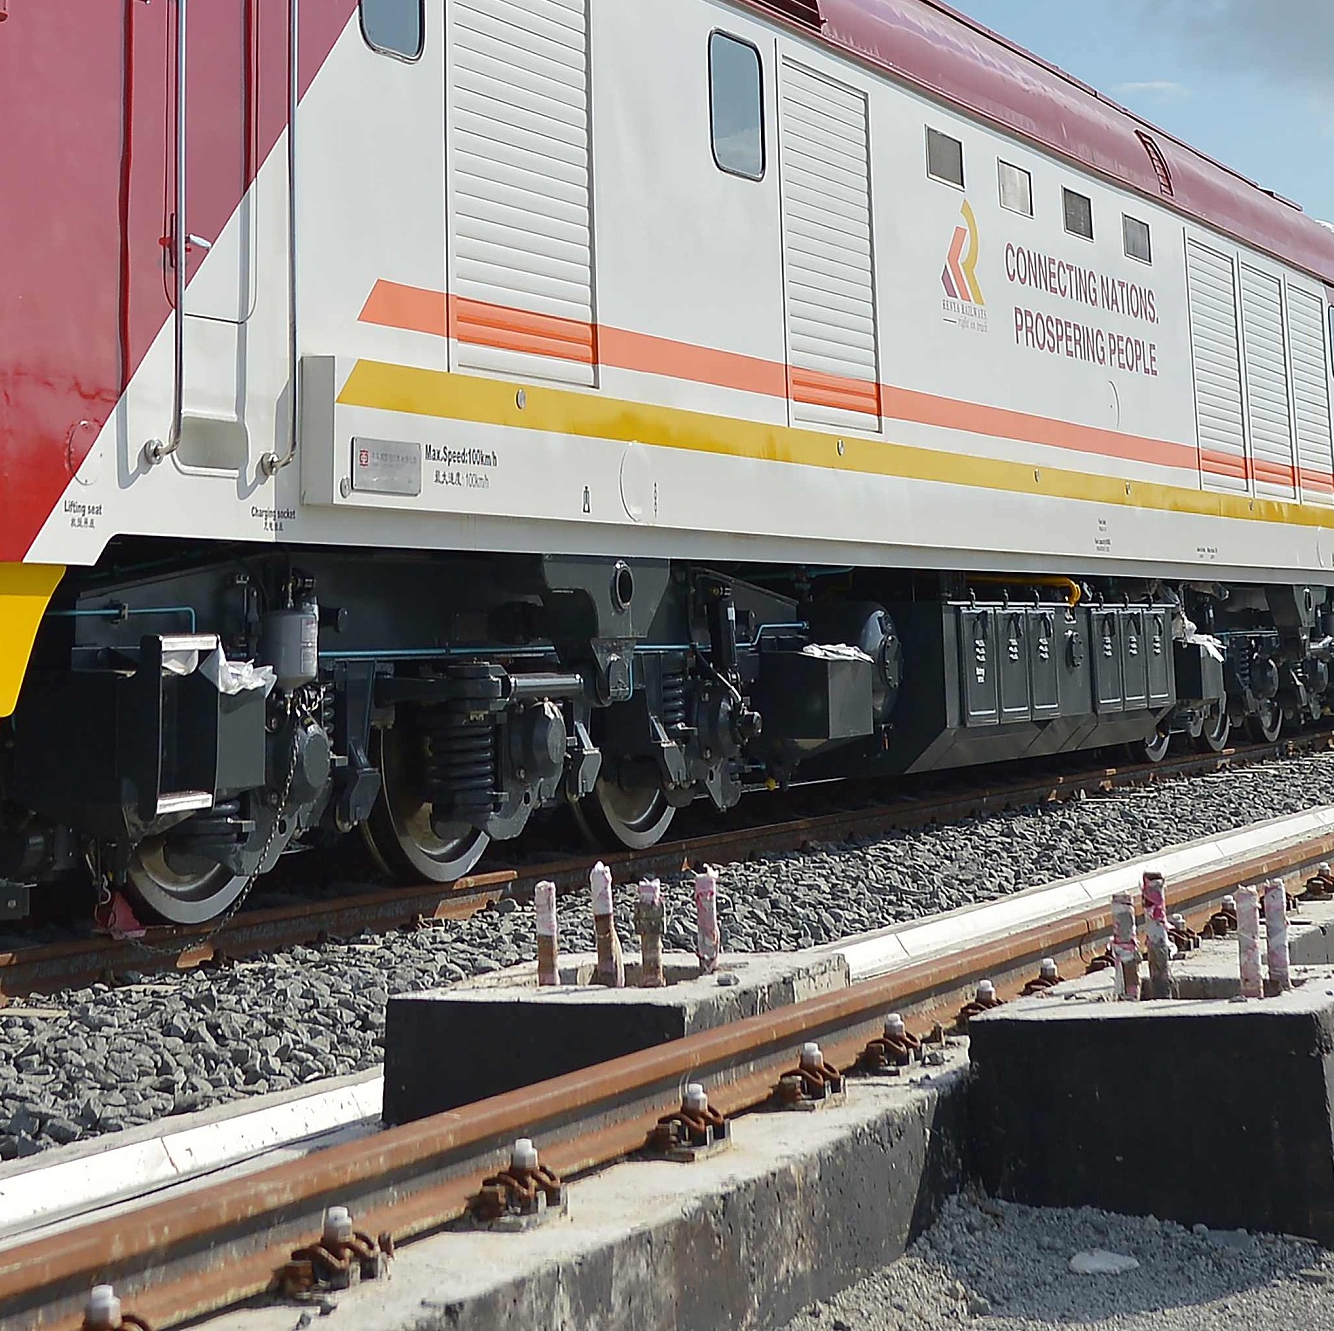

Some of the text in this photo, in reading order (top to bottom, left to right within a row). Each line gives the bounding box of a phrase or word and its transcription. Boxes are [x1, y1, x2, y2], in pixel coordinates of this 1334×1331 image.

[1005, 242, 1159, 324] CONNECTING NATIONS.
[1014, 306, 1158, 377] PROSPERING PEOPLE
[64, 500, 102, 517] Lifting seat
